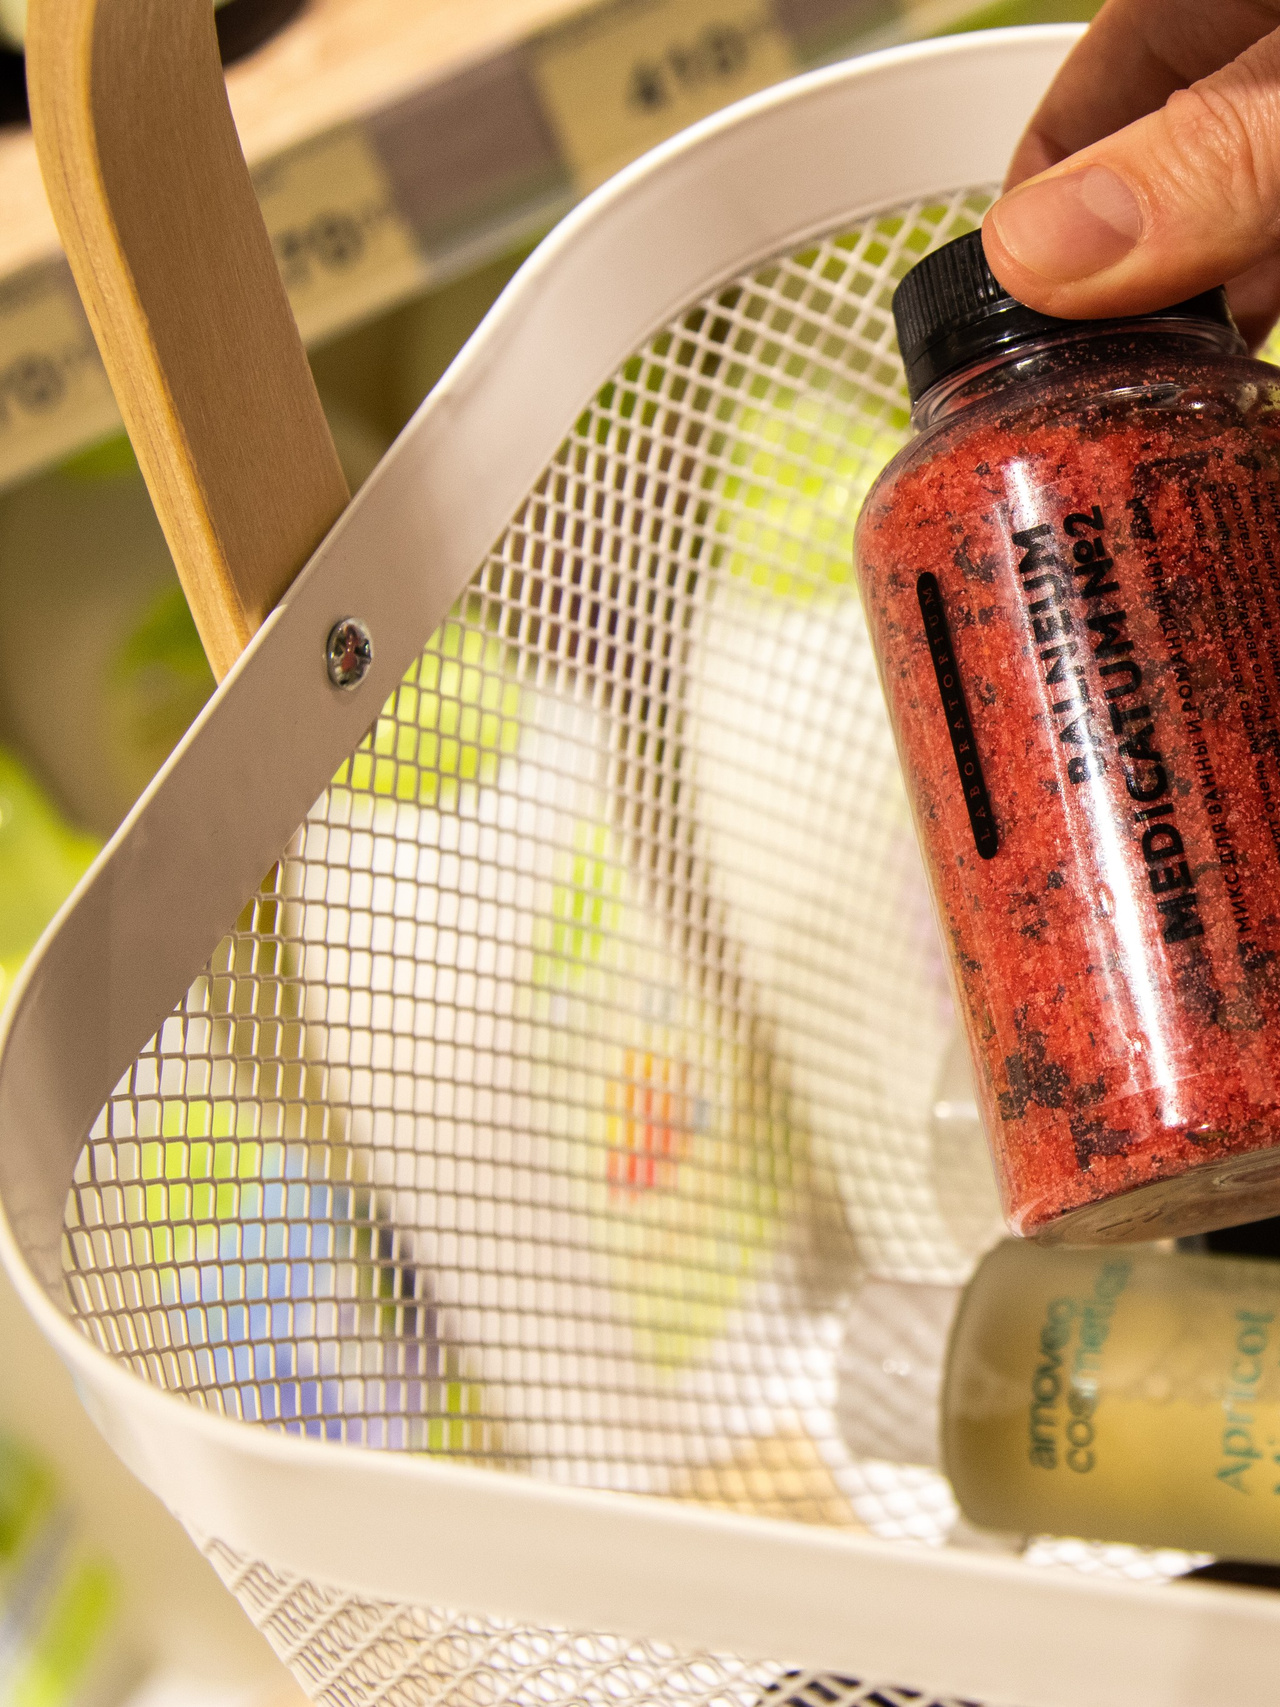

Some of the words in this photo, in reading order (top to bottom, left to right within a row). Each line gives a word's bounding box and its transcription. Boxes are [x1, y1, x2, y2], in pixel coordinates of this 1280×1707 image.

[1131, 493, 1157, 543] ДУМ
[1184, 485, 1208, 540] также
[1205, 482, 1239, 582] впитываясь
[1225, 481, 1255, 561] сладкого
[1203, 558, 1226, 598] роз,
[1246, 564, 1269, 618] масло
[1009, 521, 1109, 785] BALNEUM
[1143, 545, 1198, 712] РОМАНТИЧНЫХ
[1213, 599, 1247, 696] лепестков
[920, 585, 991, 840] LABORATORIUM
[1250, 662, 1274, 721] Масло
[1186, 718, 1203, 733] И
[1238, 699, 1262, 754] много
[1085, 608, 1204, 944] MEDICATUM
[1191, 739, 1223, 816] ВАННЫ
[1253, 759, 1277, 814] очень
[1211, 821, 1237, 867] ДЛЯ
[1223, 871, 1251, 933] МИКС
[1216, 1308, 1275, 1497] Apricot
